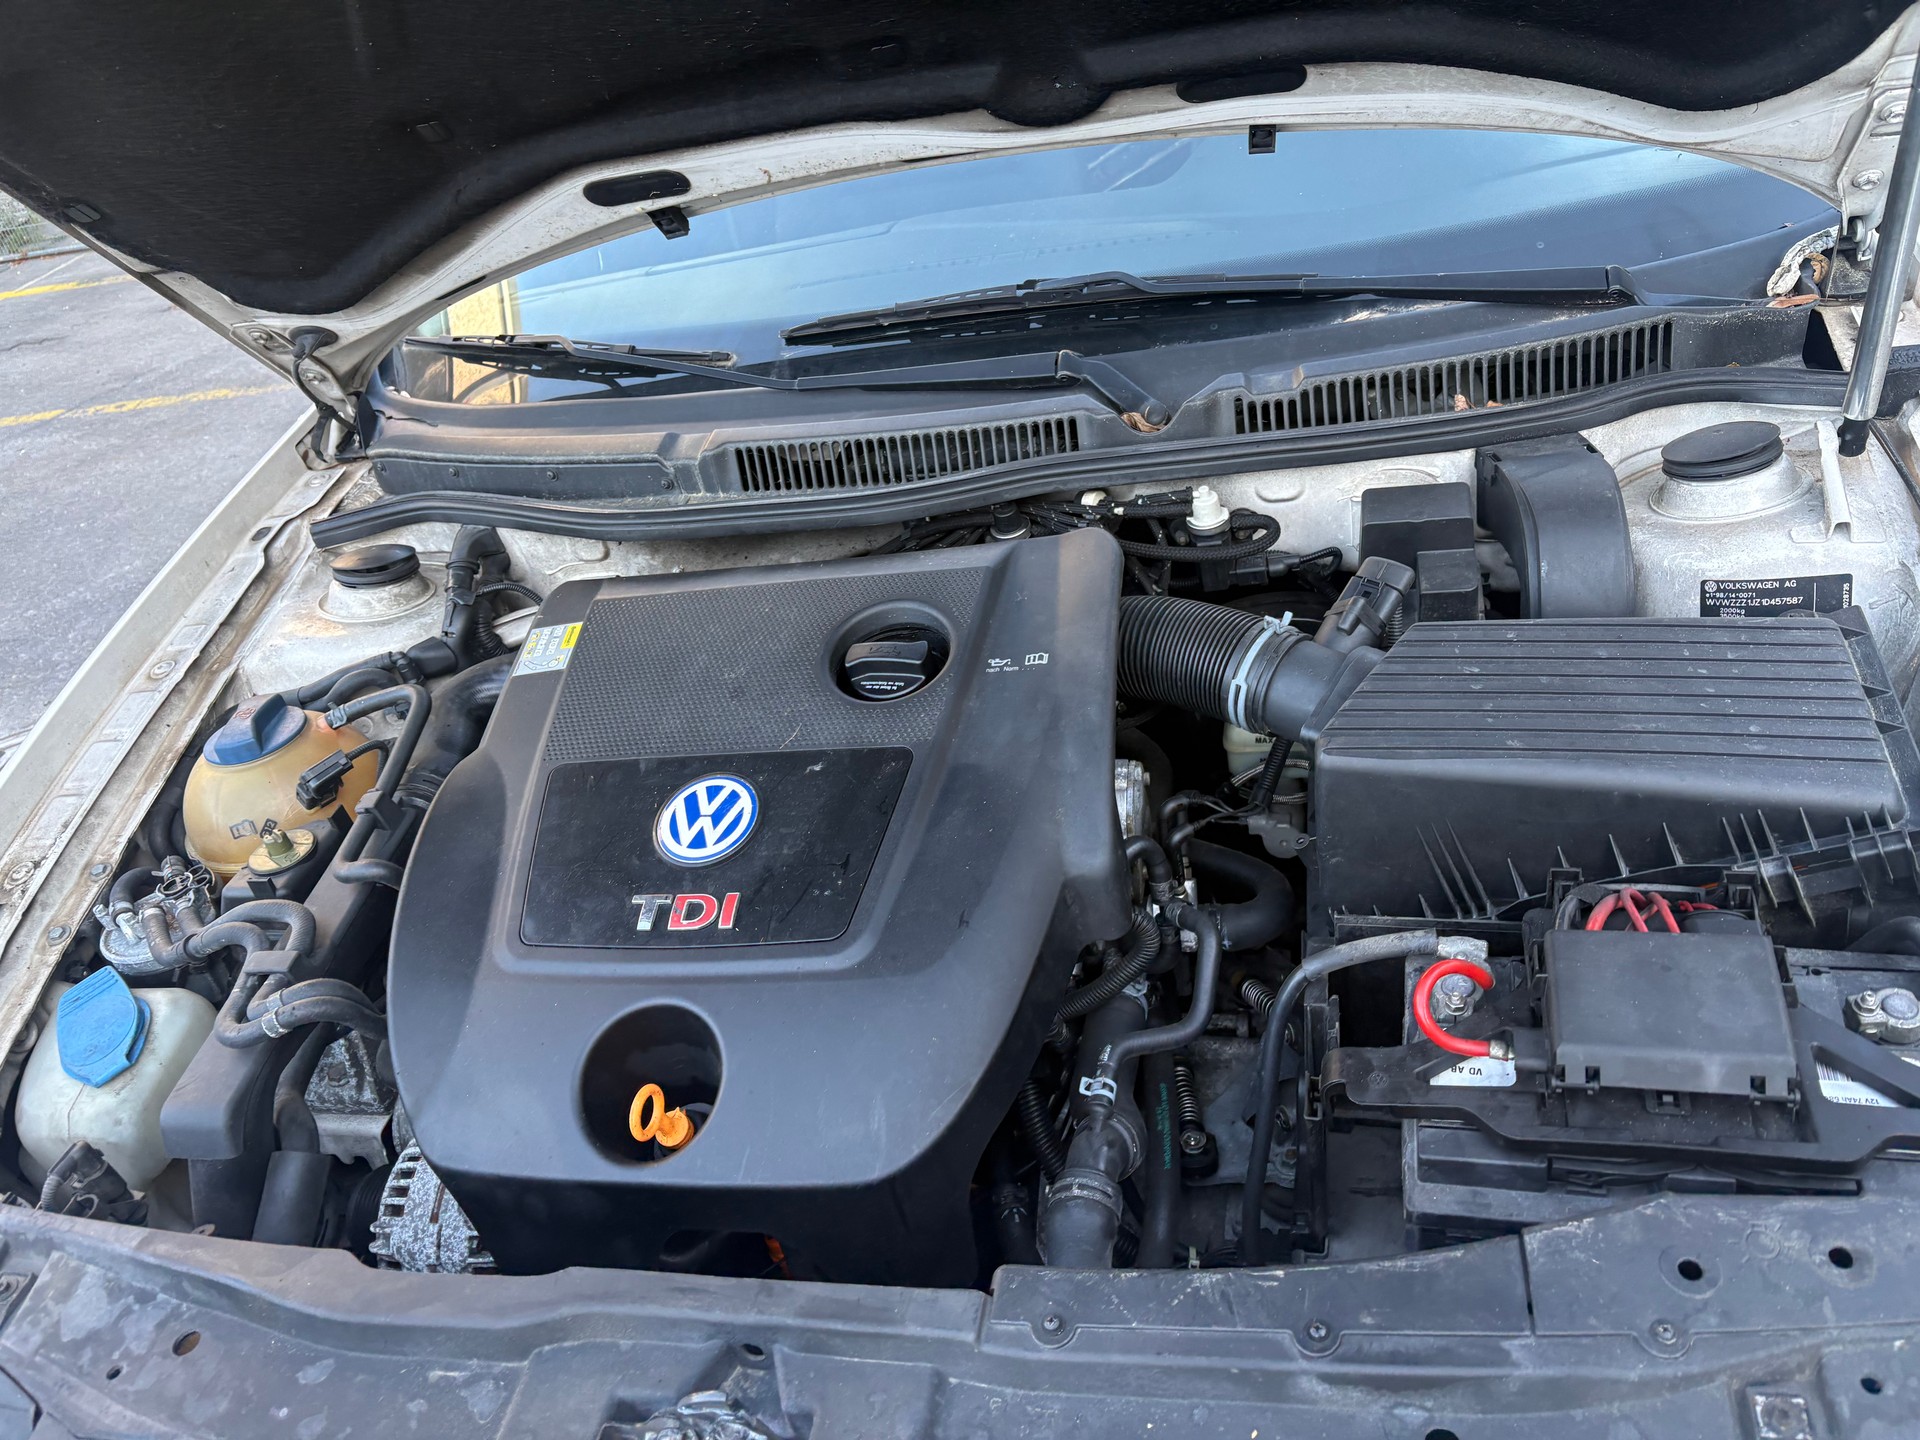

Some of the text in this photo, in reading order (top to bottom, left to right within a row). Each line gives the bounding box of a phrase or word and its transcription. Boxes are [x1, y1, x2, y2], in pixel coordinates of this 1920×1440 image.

[1718, 581, 1780, 590] VOLKSWAGEN
[1784, 580, 1797, 588] AG
[1720, 607, 1746, 615] 2000kg
[658, 778, 752, 858] VW
[631, 892, 741, 931] TDI
